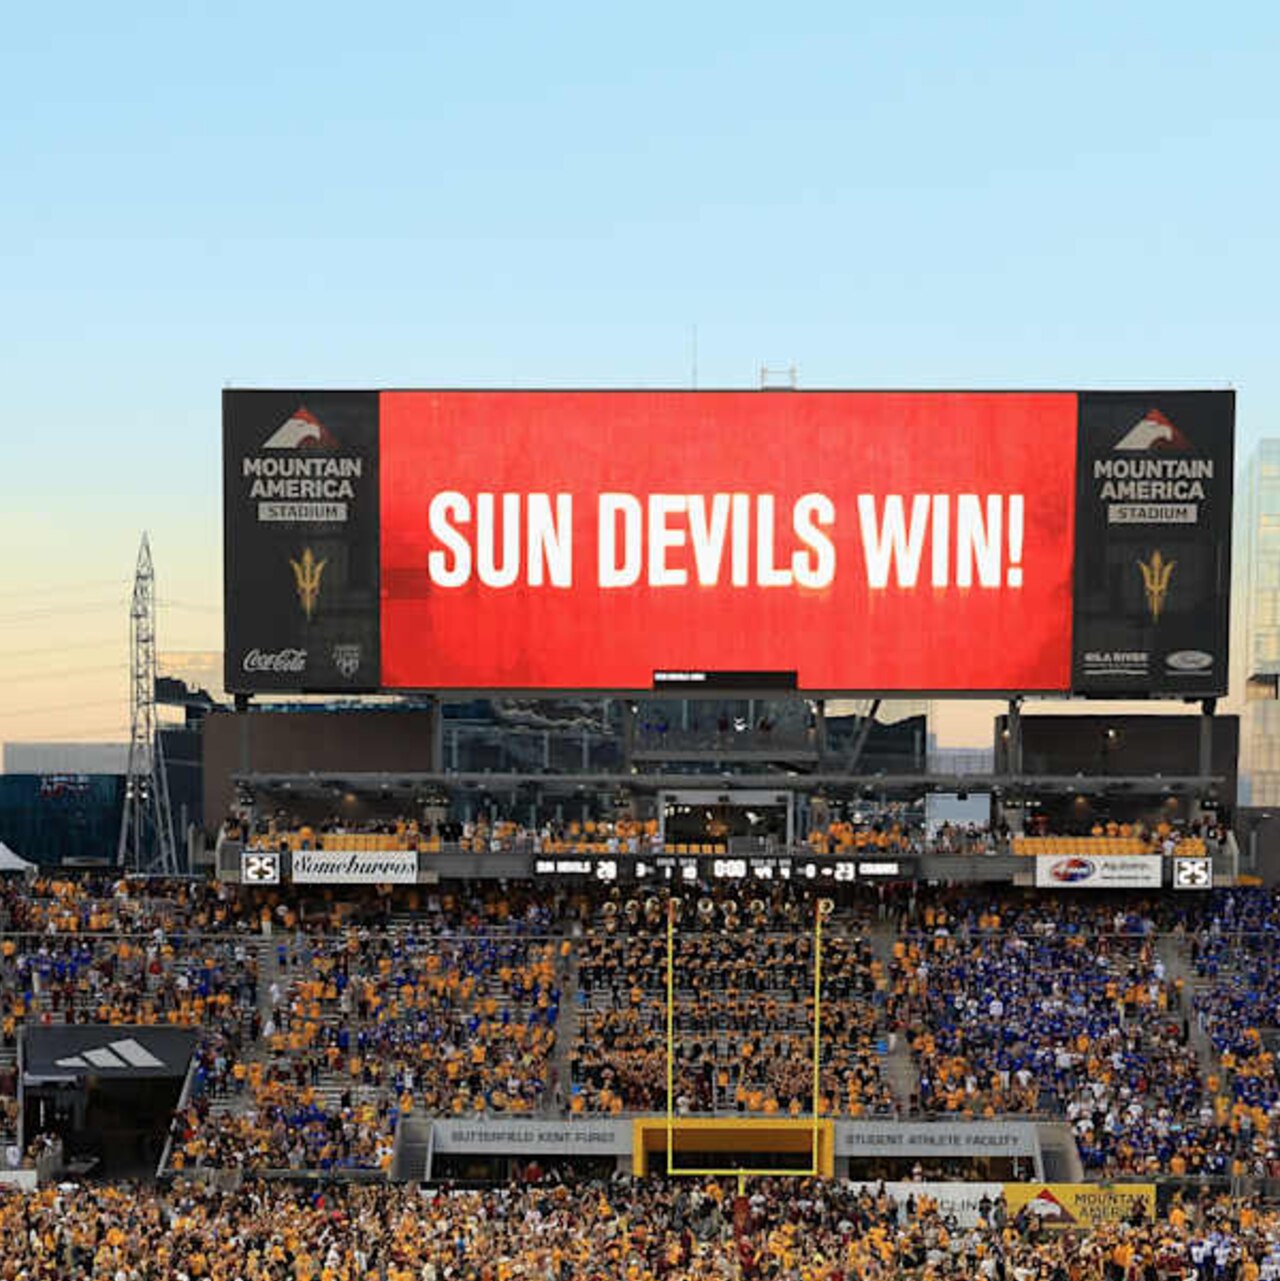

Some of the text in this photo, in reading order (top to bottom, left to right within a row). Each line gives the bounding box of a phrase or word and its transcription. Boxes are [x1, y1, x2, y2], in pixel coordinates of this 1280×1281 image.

[242, 457, 362, 477] MOUNTAIN
[1093, 459, 1213, 479] MOUNTAIN
[250, 479, 354, 498] AMERICA
[1100, 481, 1205, 500] AMERICA
[268, 505, 339, 518] STADIUM
[1117, 506, 1188, 520] STADIUM
[427, 491, 1026, 590] SUN DEVILS WIN!
[293, 854, 416, 875] Someburros
[451, 1131, 534, 1143] BUTTERFIELD
[845, 1134, 1019, 1145] STUDENT ATHLETE FACILITY
